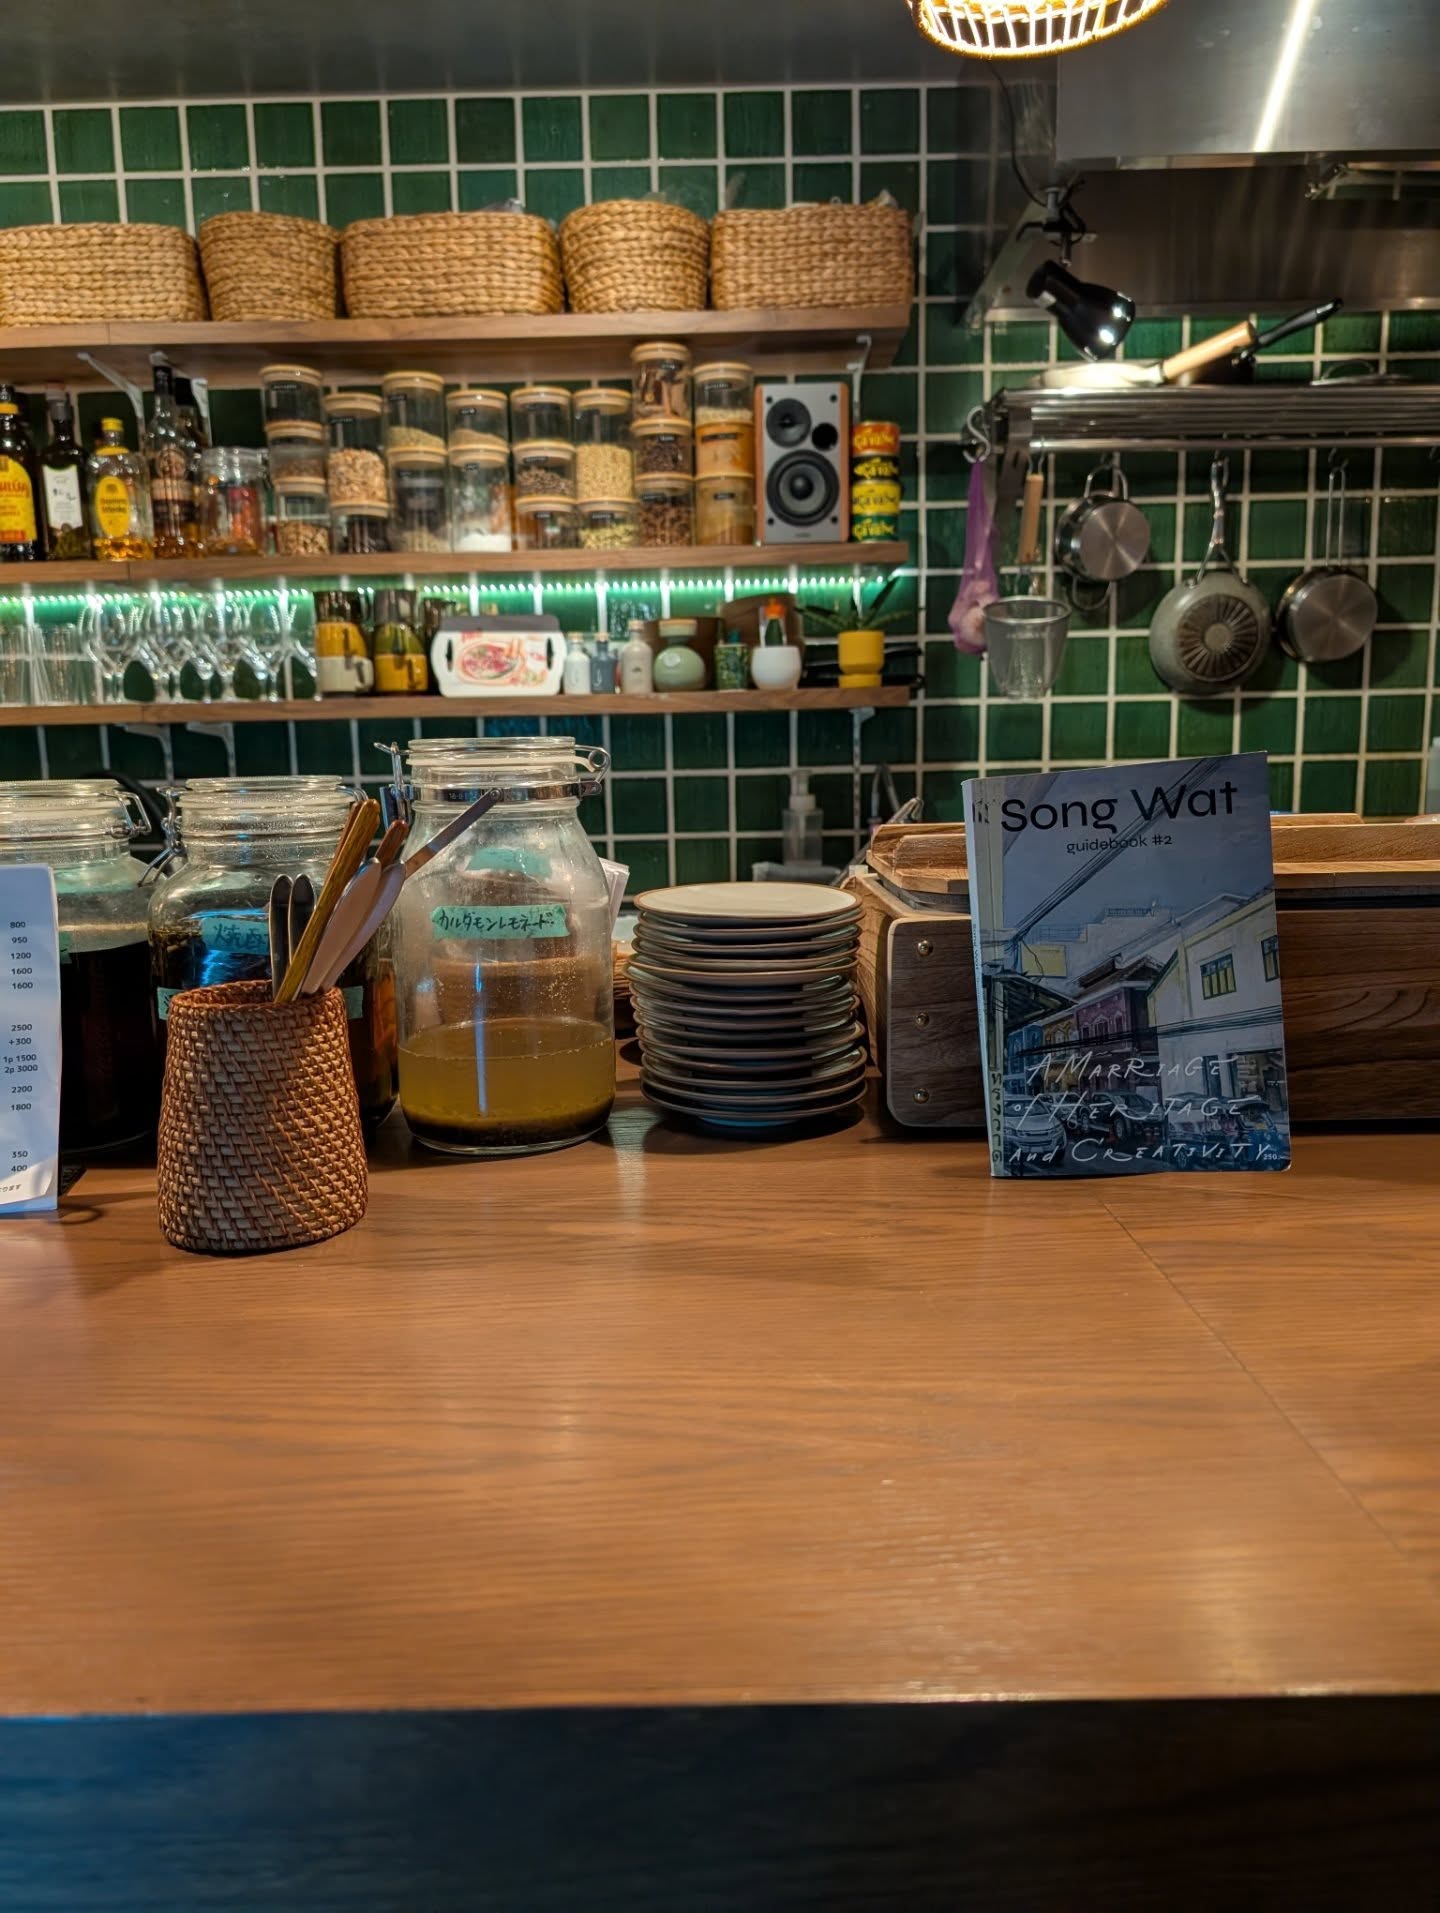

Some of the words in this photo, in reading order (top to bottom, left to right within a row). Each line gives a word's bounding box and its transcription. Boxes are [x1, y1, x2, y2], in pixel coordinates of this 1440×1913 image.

[1000, 798, 1119, 834] Song
[1130, 781, 1238, 822] Wat
[1066, 836, 1147, 855] guidebook
[1152, 834, 1172, 846] #2
[10, 921, 26, 929] 800
[11, 936, 28, 944] 950
[10, 952, 32, 960] 1200
[11, 967, 33, 975] 1600
[12, 982, 33, 990] 1600
[11, 1023, 33, 1032] 2500
[3, 1056, 14, 1065] 1p
[16, 1054, 37, 1062] 1500
[17, 1064, 38, 1072] 3000
[1027, 1053, 1053, 1085] A
[11, 1085, 33, 1094] 2200
[11, 1102, 32, 1111] 1800
[12, 1150, 28, 1159] 350
[11, 1164, 28, 1173] 400
[0, 1182, 22, 1193] ります
